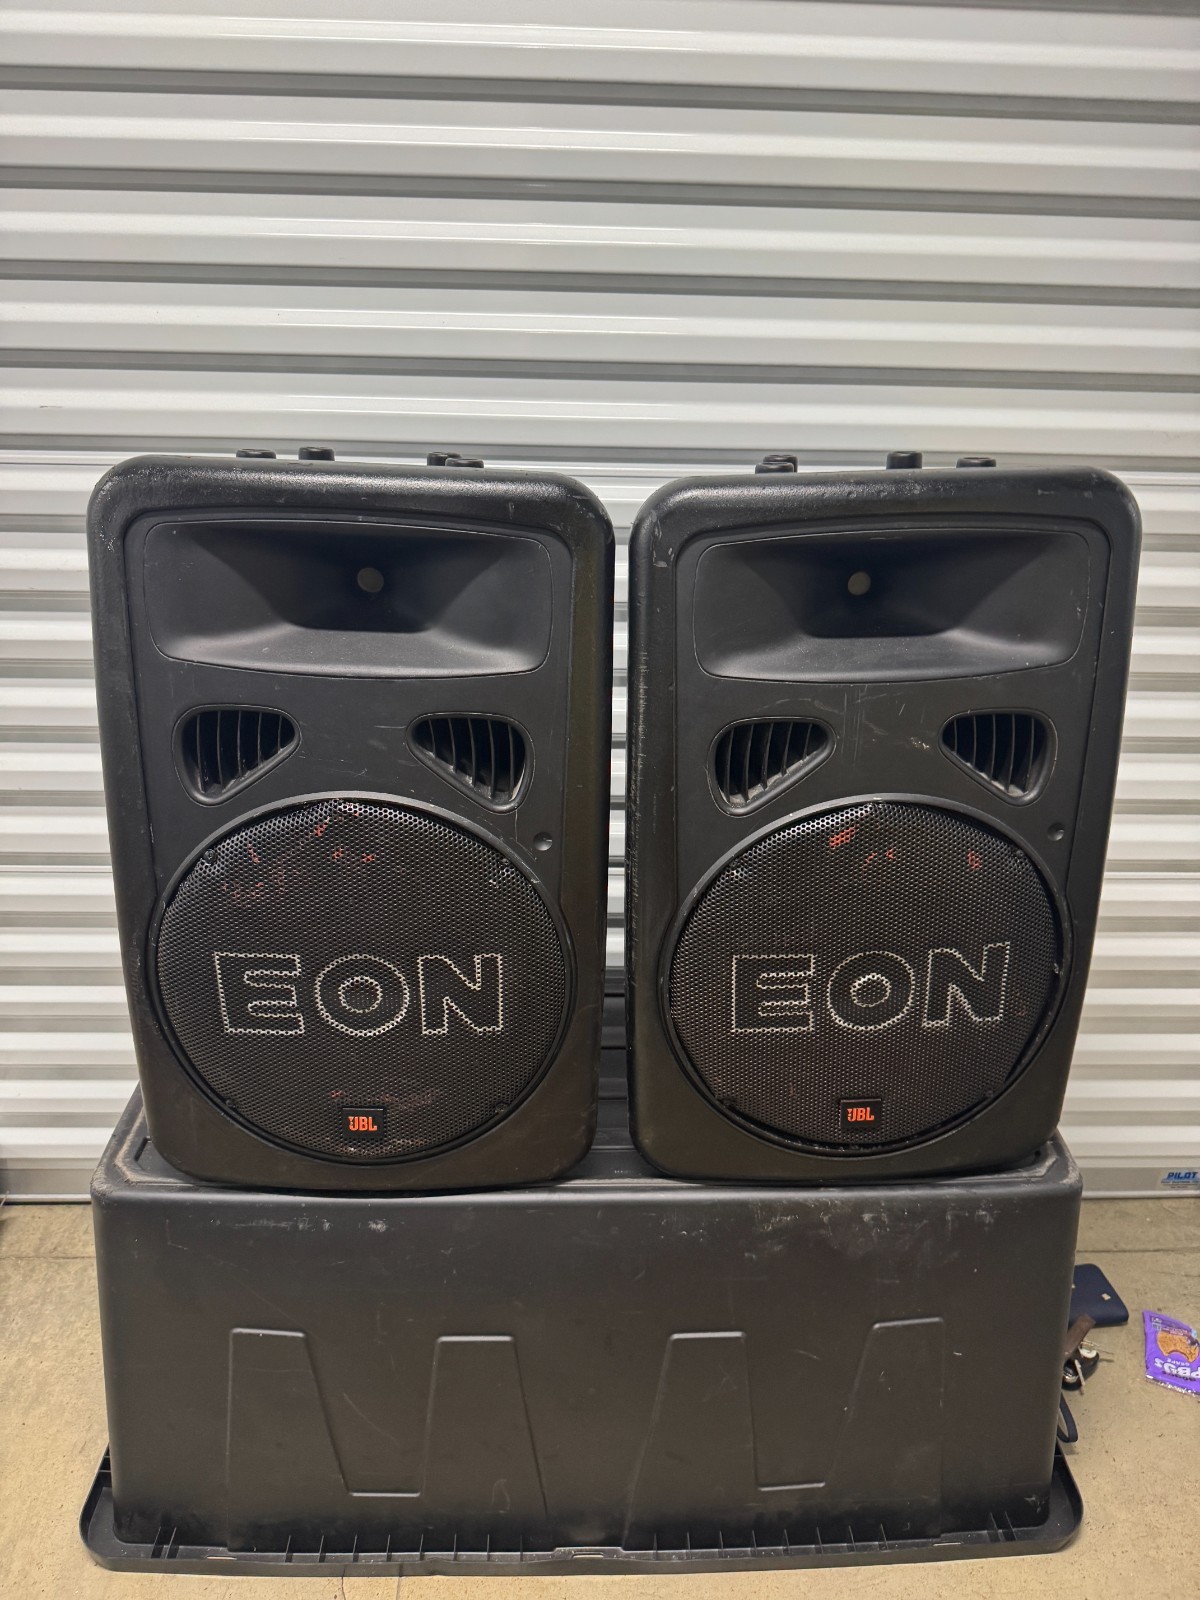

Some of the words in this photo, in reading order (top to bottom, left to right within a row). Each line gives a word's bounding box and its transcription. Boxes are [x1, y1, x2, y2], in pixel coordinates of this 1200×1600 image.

[212, 952, 503, 1036] EON
[731, 942, 1011, 1032] EON
[847, 1107, 875, 1122] JBL
[348, 1116, 378, 1131] JBL
[1167, 1171, 1198, 1180] PILOT
